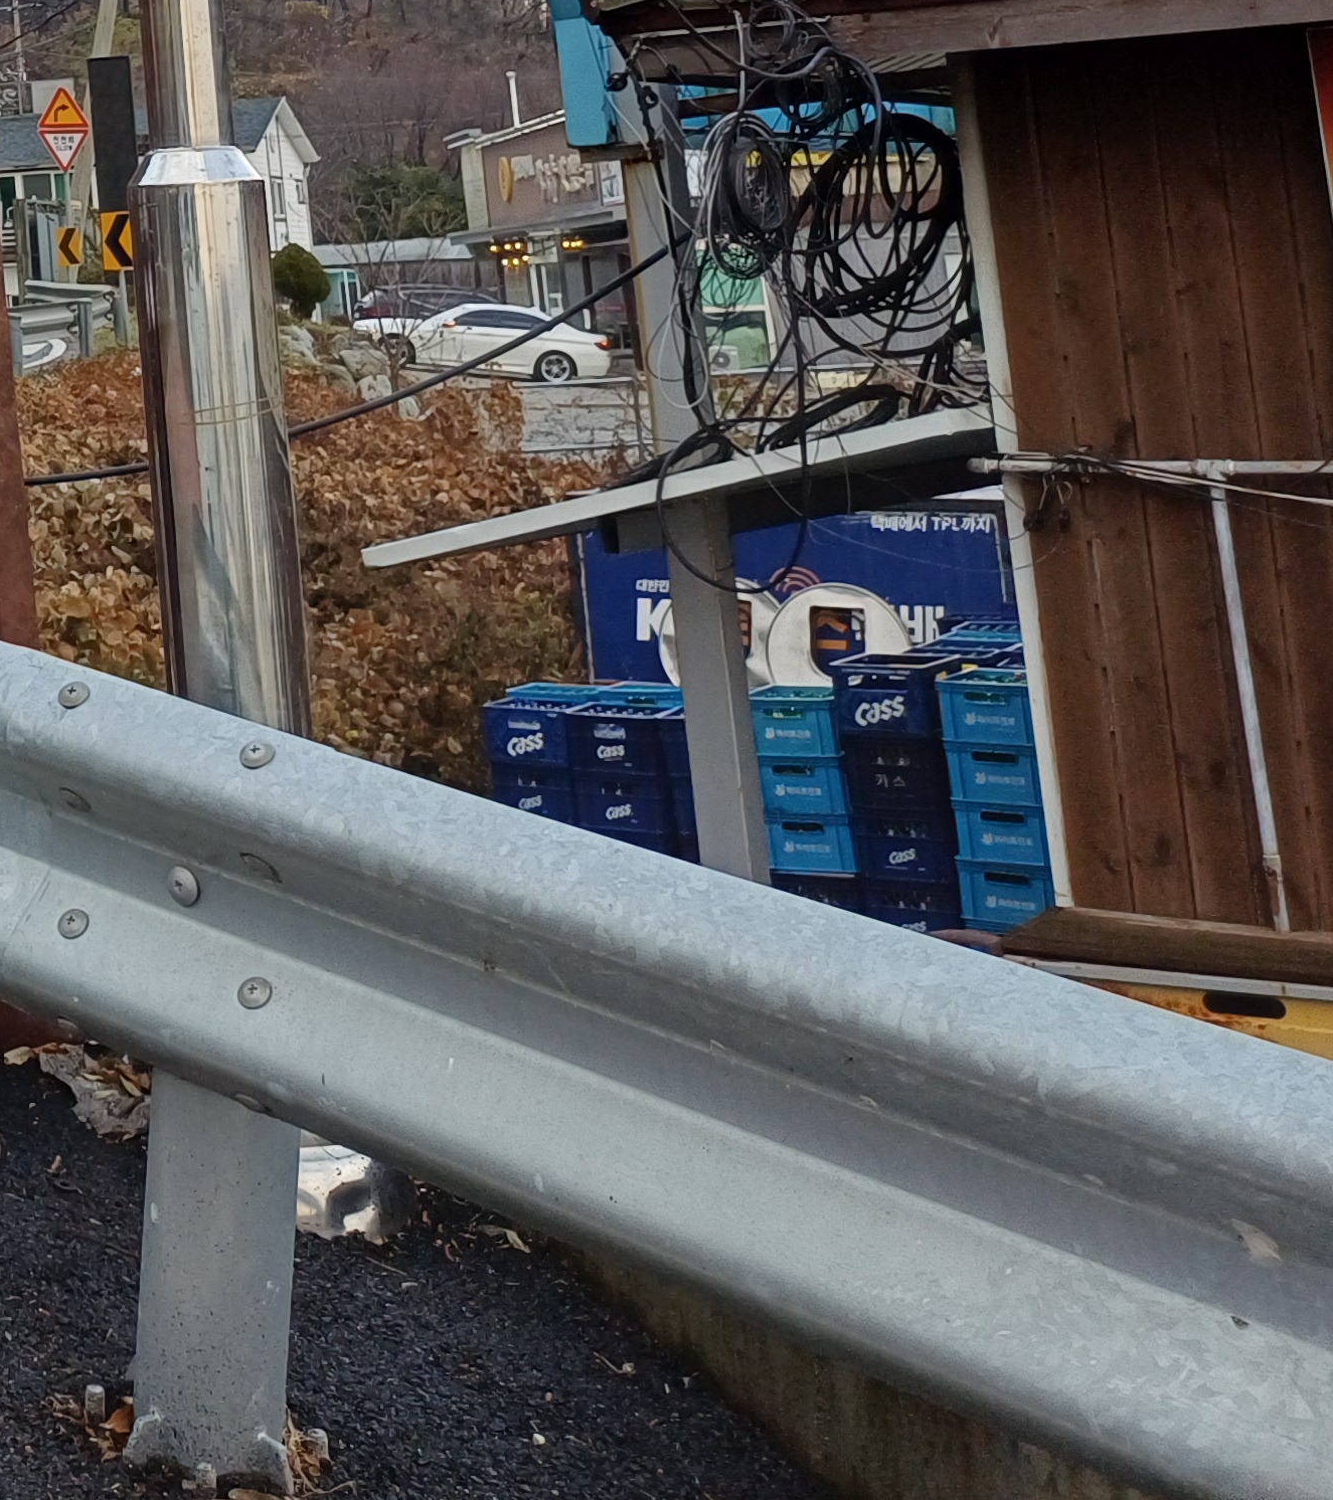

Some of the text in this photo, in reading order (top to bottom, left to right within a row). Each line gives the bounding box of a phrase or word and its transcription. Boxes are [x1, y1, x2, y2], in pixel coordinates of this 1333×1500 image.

[870, 514, 928, 533] 택배에서
[854, 695, 906, 727] Cass
[507, 732, 544, 758] Cass
[596, 744, 625, 759] Cass
[874, 774, 906, 788] 카스
[605, 803, 632, 821] Cass
[889, 848, 916, 865] Cass
